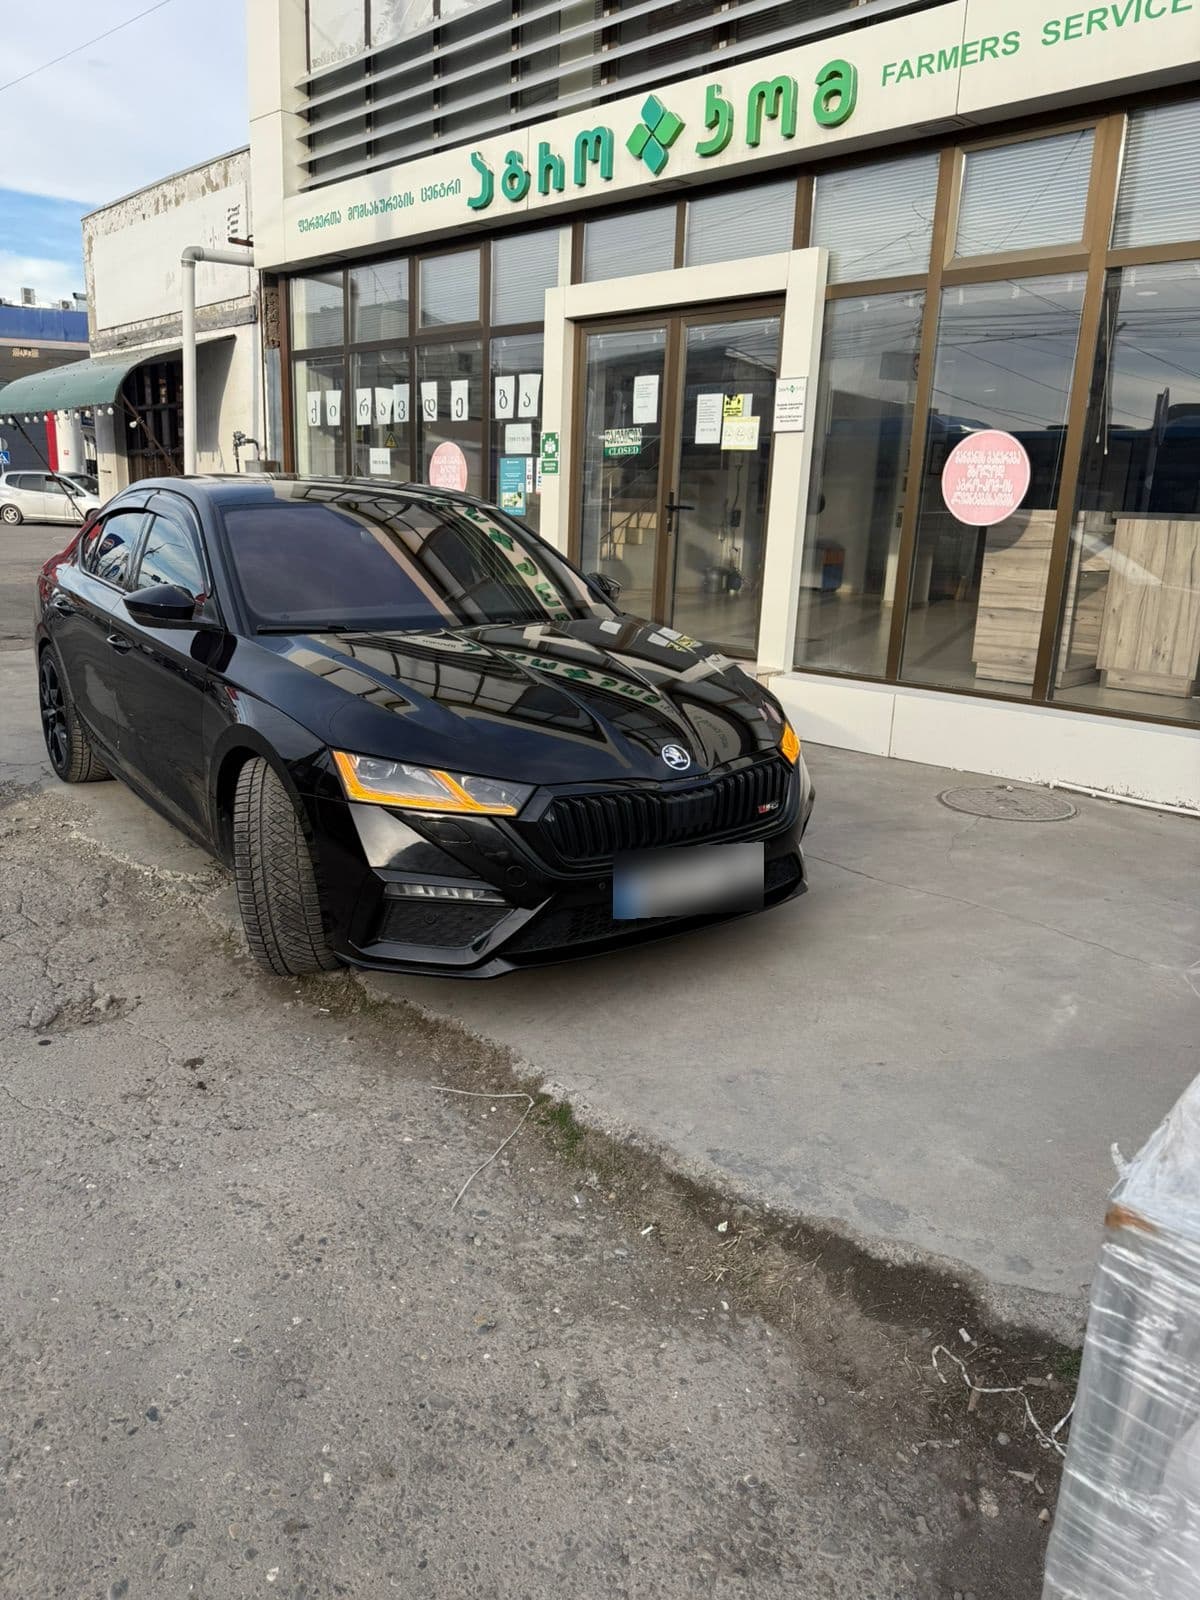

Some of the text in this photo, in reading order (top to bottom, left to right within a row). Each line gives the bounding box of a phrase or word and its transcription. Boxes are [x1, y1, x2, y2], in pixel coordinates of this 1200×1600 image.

[881, 31, 1021, 87] FARMERS
[465, 58, 860, 211] აგრო კომ
[298, 178, 462, 233] ფერმერთა მომსახურების ცენტრი
[608, 446, 640, 457] CLOSED
